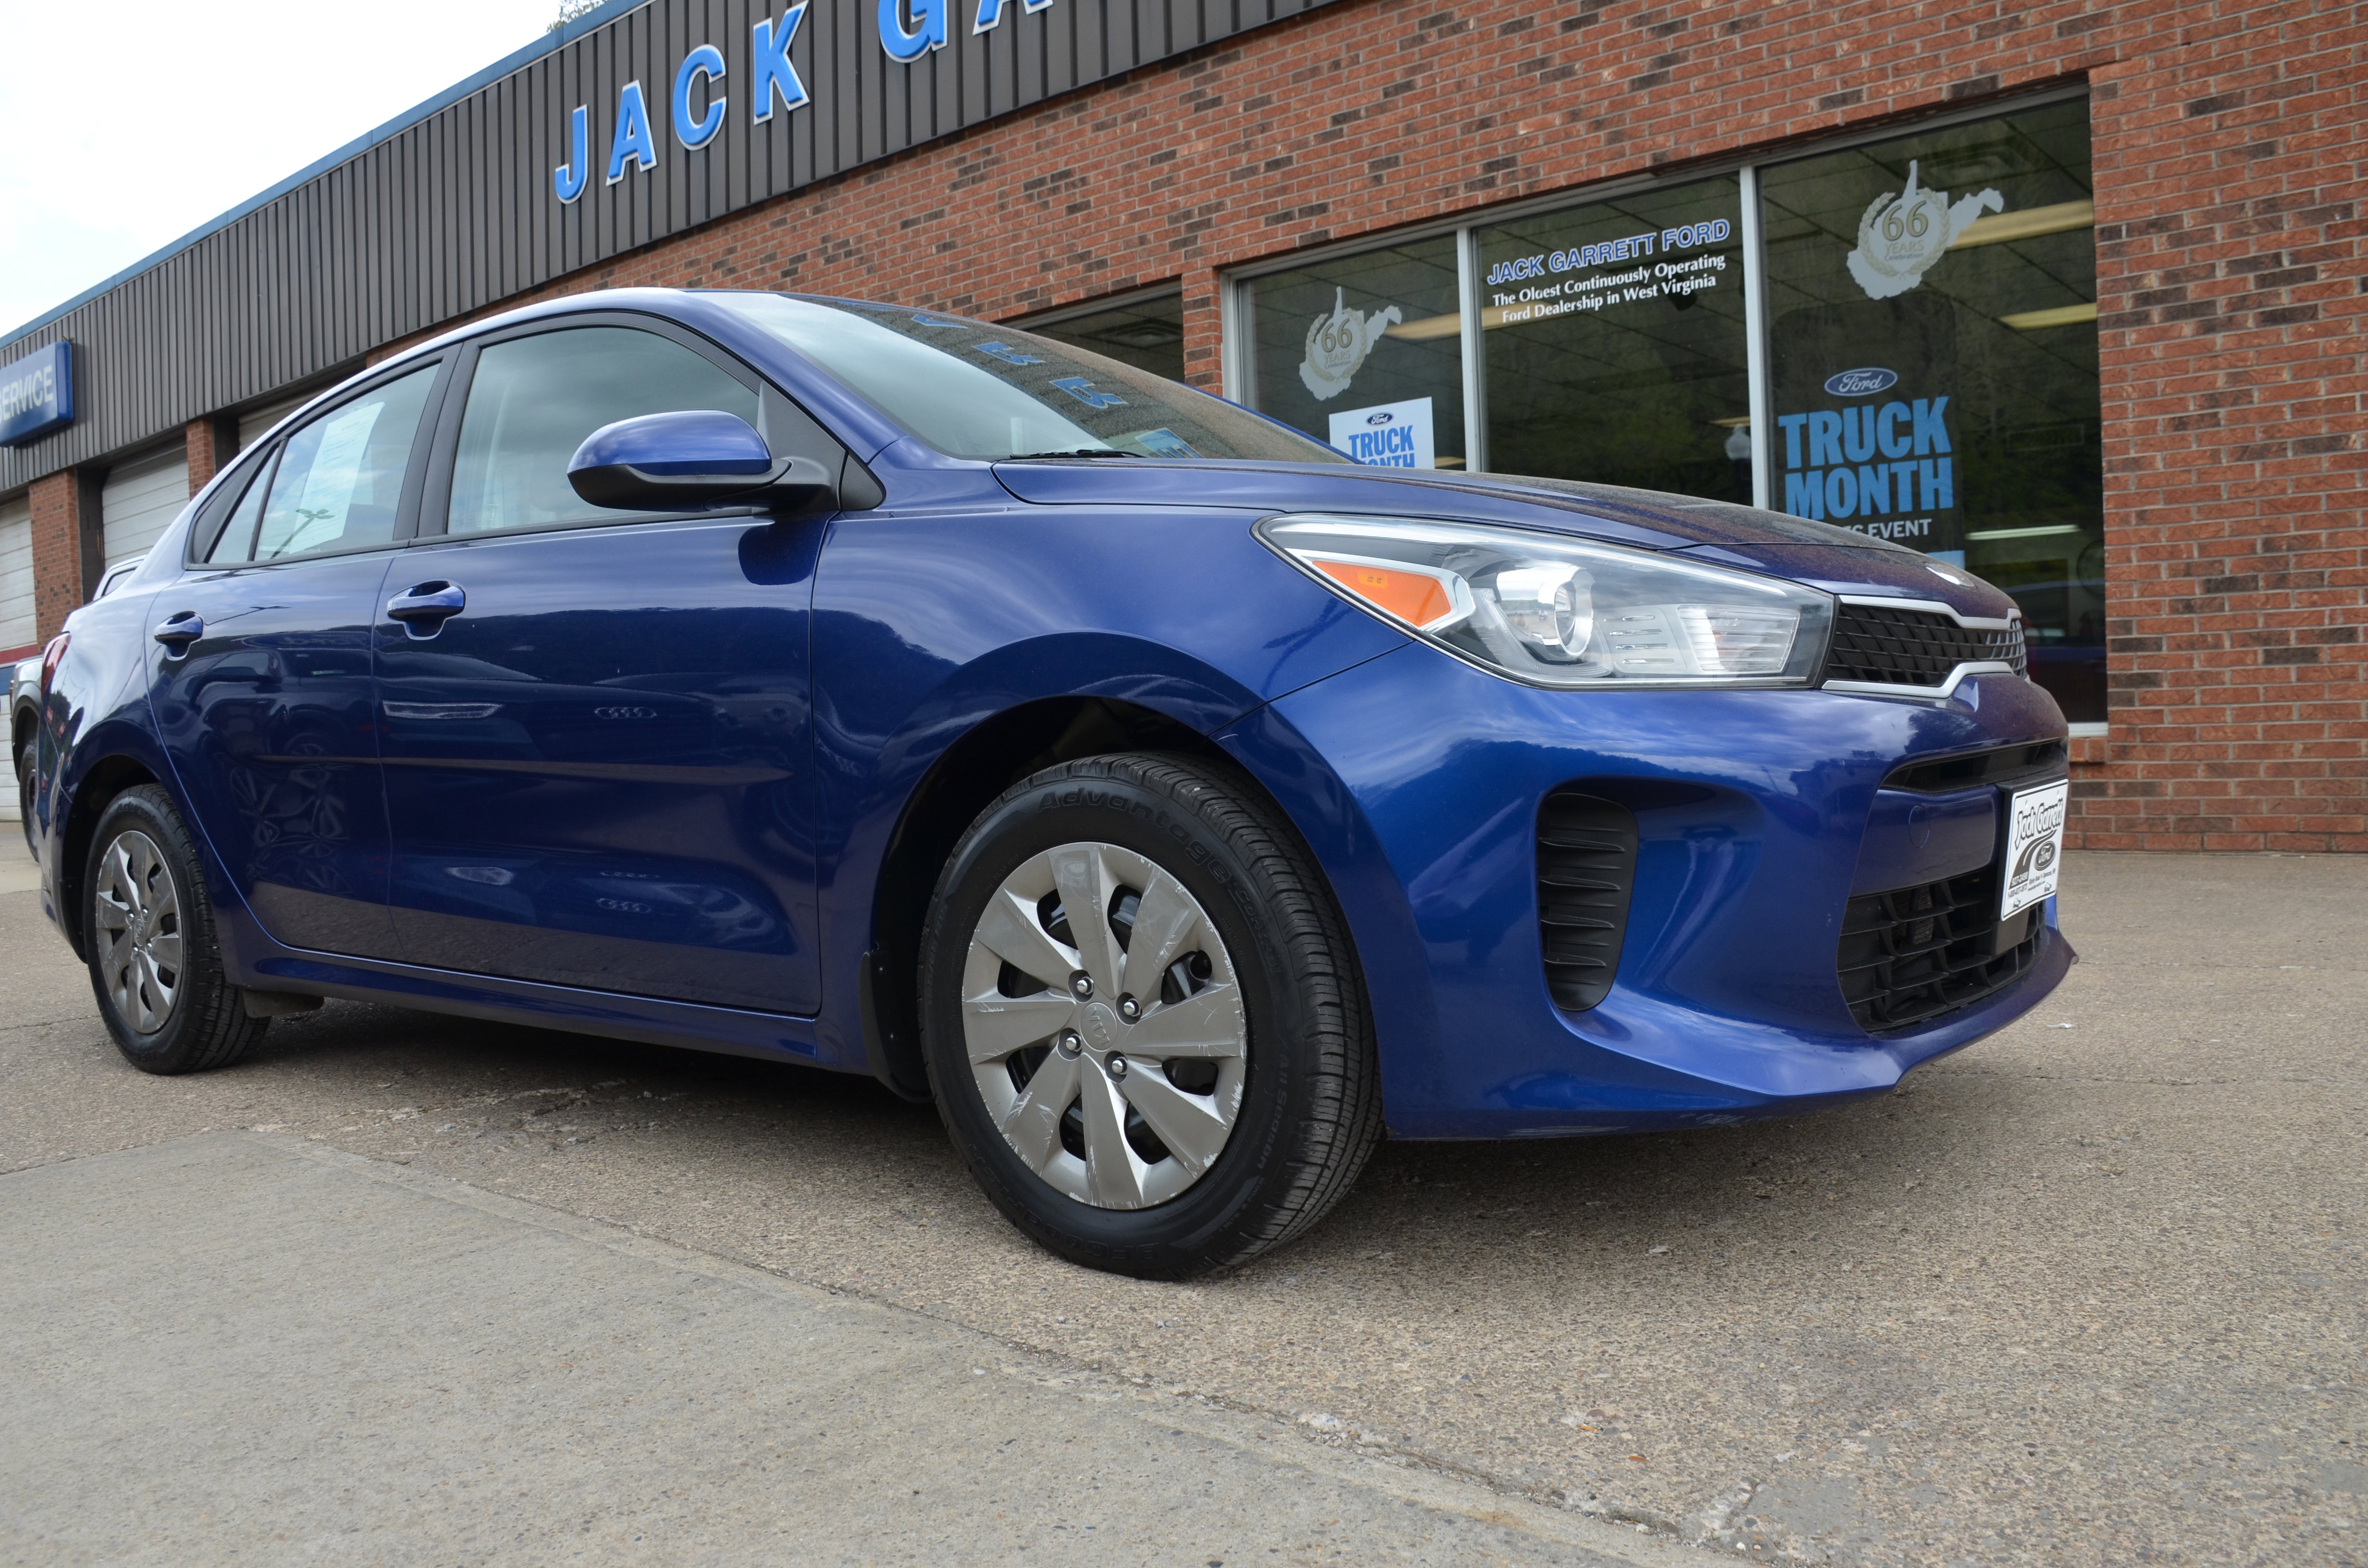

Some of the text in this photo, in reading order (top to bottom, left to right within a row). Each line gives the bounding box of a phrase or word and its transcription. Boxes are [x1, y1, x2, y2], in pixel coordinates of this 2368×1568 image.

[554, 0, 1053, 204] JACK G
[1882, 200, 1928, 241] 66
[1487, 219, 1730, 285] JACK GARRETT FORD
[1884, 240, 1924, 255] YEARS
[1493, 293, 1516, 306] The
[1564, 267, 1651, 294] Continuously
[1654, 253, 1725, 277] Operating
[1502, 275, 1716, 323] Ford Dealership in West Virginia
[1321, 318, 1352, 352] 66
[1323, 350, 1351, 362] YEARS
[1838, 370, 1884, 393] Ford
[1348, 425, 1414, 459] TRUCK
[1778, 396, 1952, 469] TRUCK
[1785, 457, 1954, 520] MONTH
[1868, 518, 1932, 539] EVENT
[1036, 788, 1233, 884] Advantage
[2015, 798, 2064, 850] Jack Garrett
[2038, 845, 2053, 864] Ford
[1256, 1088, 1288, 1169] Season
